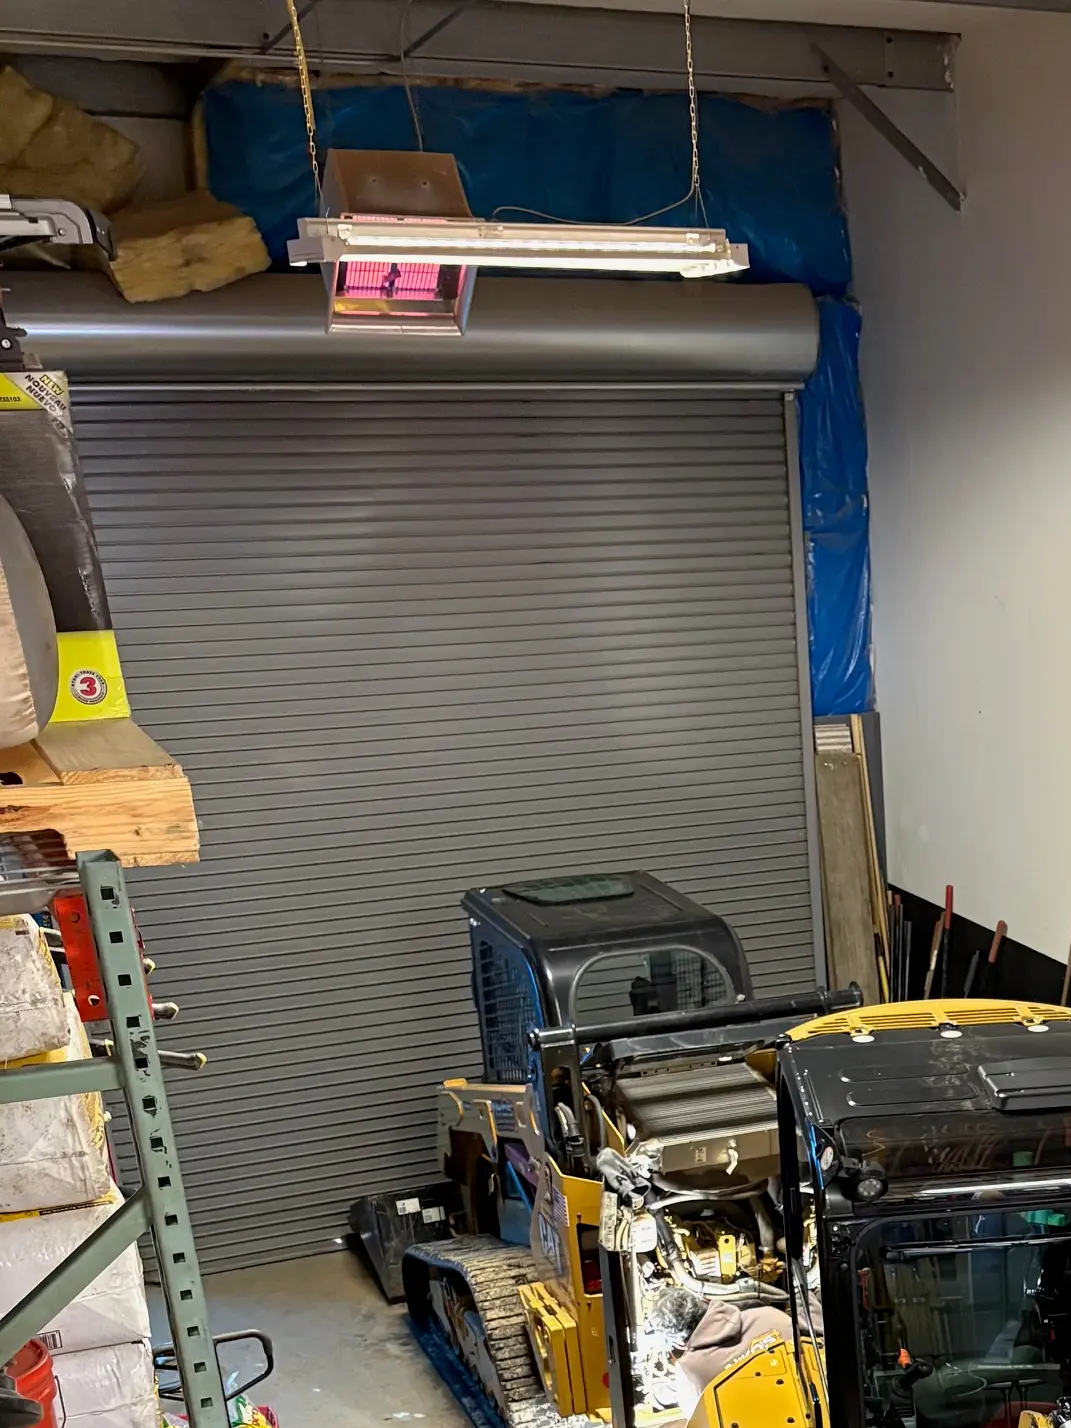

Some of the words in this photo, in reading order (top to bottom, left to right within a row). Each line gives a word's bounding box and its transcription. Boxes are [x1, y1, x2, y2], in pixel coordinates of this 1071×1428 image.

[25, 374, 67, 410] NOUVEAU
[40, 374, 64, 395] NEW
[26, 385, 57, 412] NUEVO
[80, 676, 97, 697] 3
